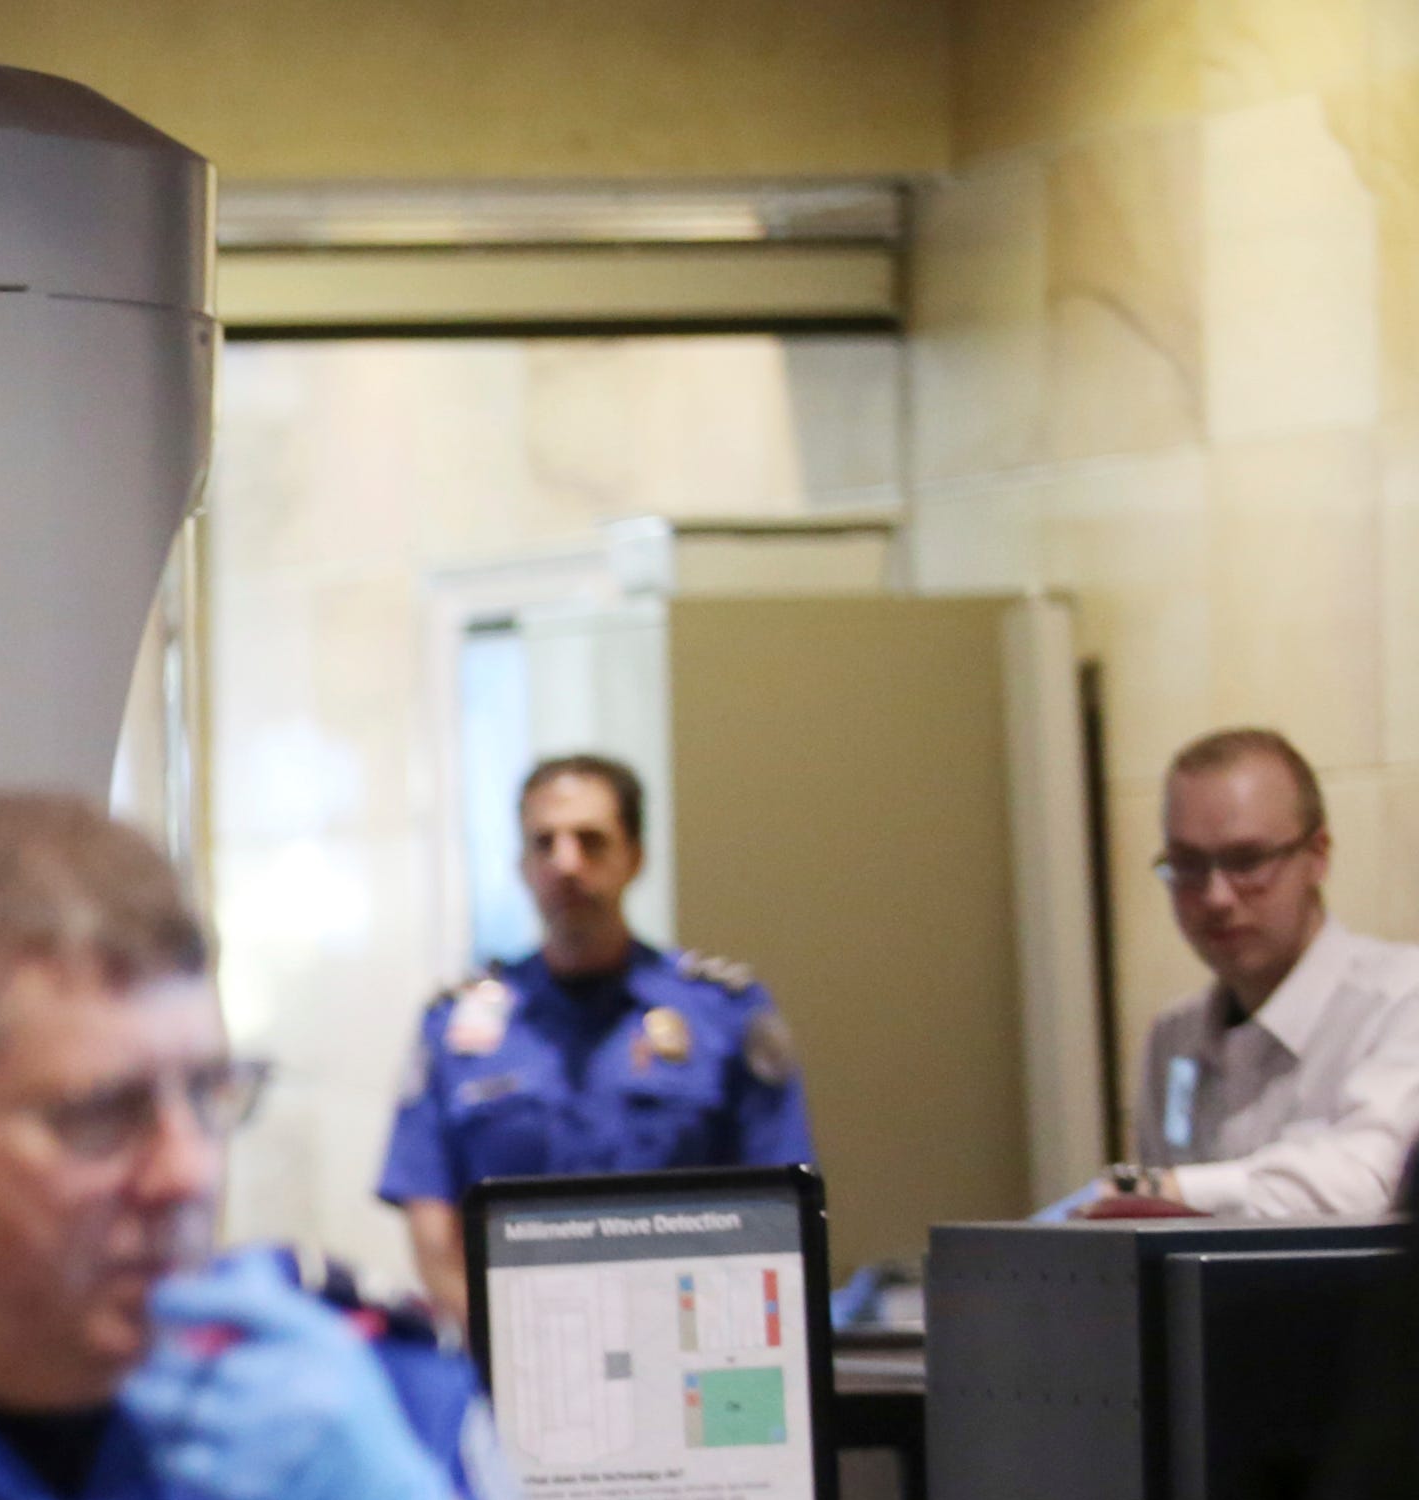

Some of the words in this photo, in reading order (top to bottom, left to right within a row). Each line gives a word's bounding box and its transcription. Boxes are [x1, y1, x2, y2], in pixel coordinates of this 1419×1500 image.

[504, 1219, 597, 1242] Millimeter
[597, 1216, 652, 1238] Wave
[652, 1210, 742, 1234] Detection
